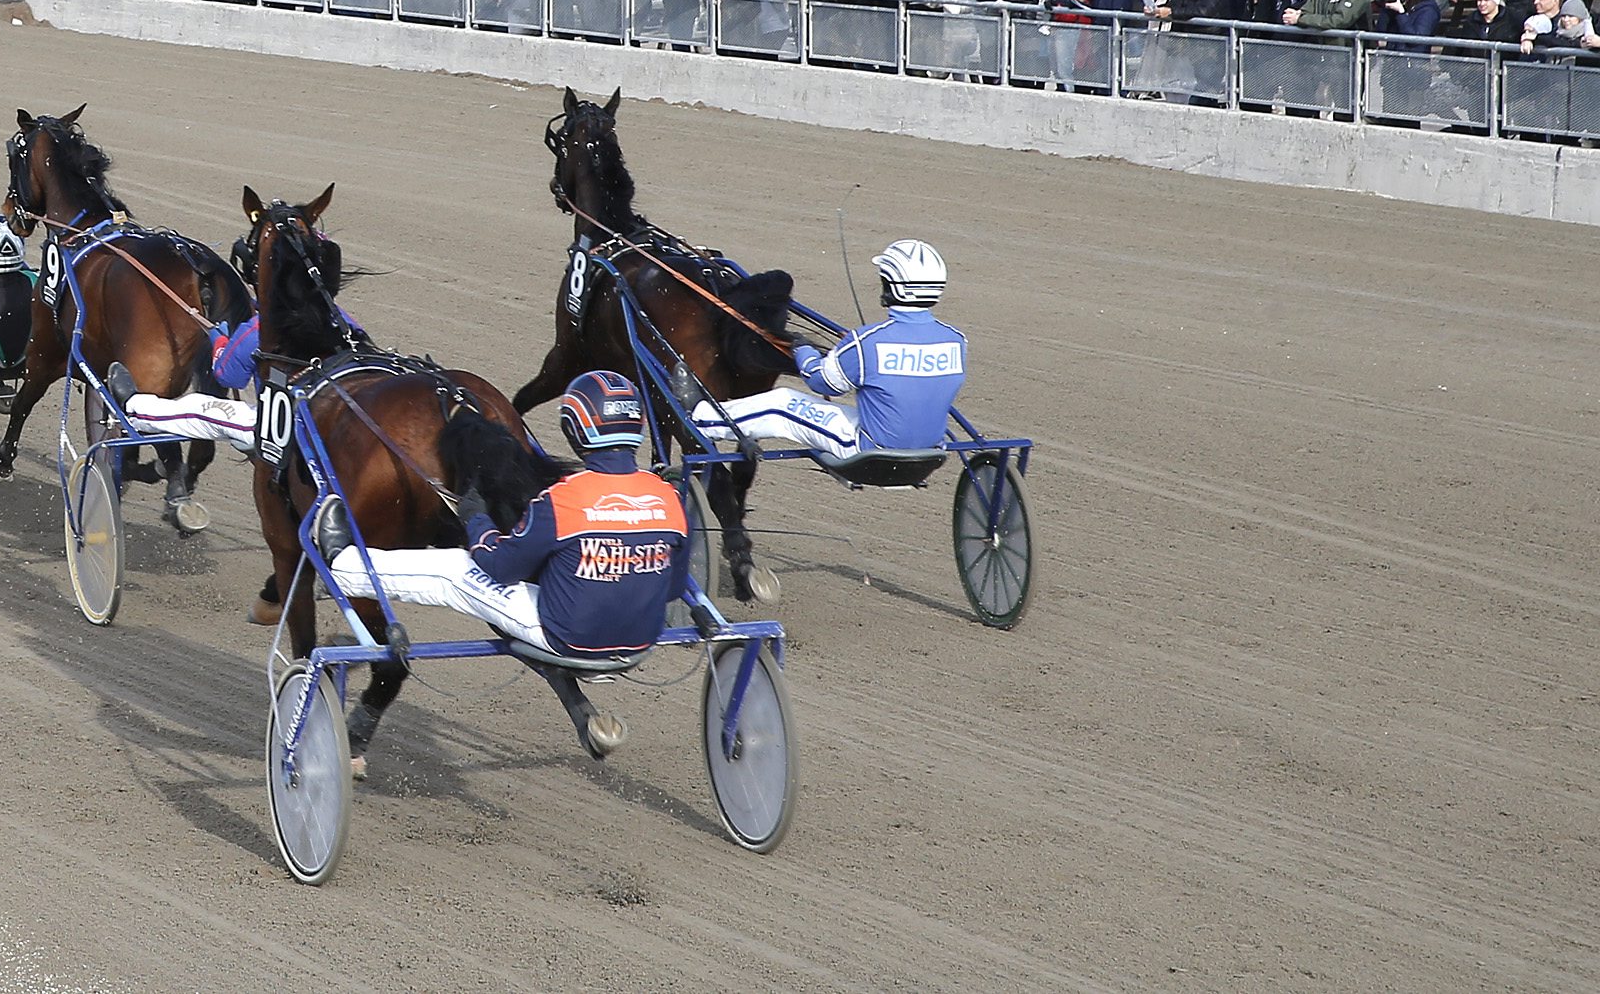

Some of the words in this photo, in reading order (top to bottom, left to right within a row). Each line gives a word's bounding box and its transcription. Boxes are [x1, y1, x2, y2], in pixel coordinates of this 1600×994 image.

[46, 243, 60, 289] 9
[570, 251, 587, 297] 8
[884, 347, 958, 372] ahlsell
[260, 385, 292, 447] 10
[787, 397, 838, 427] ahlsell
